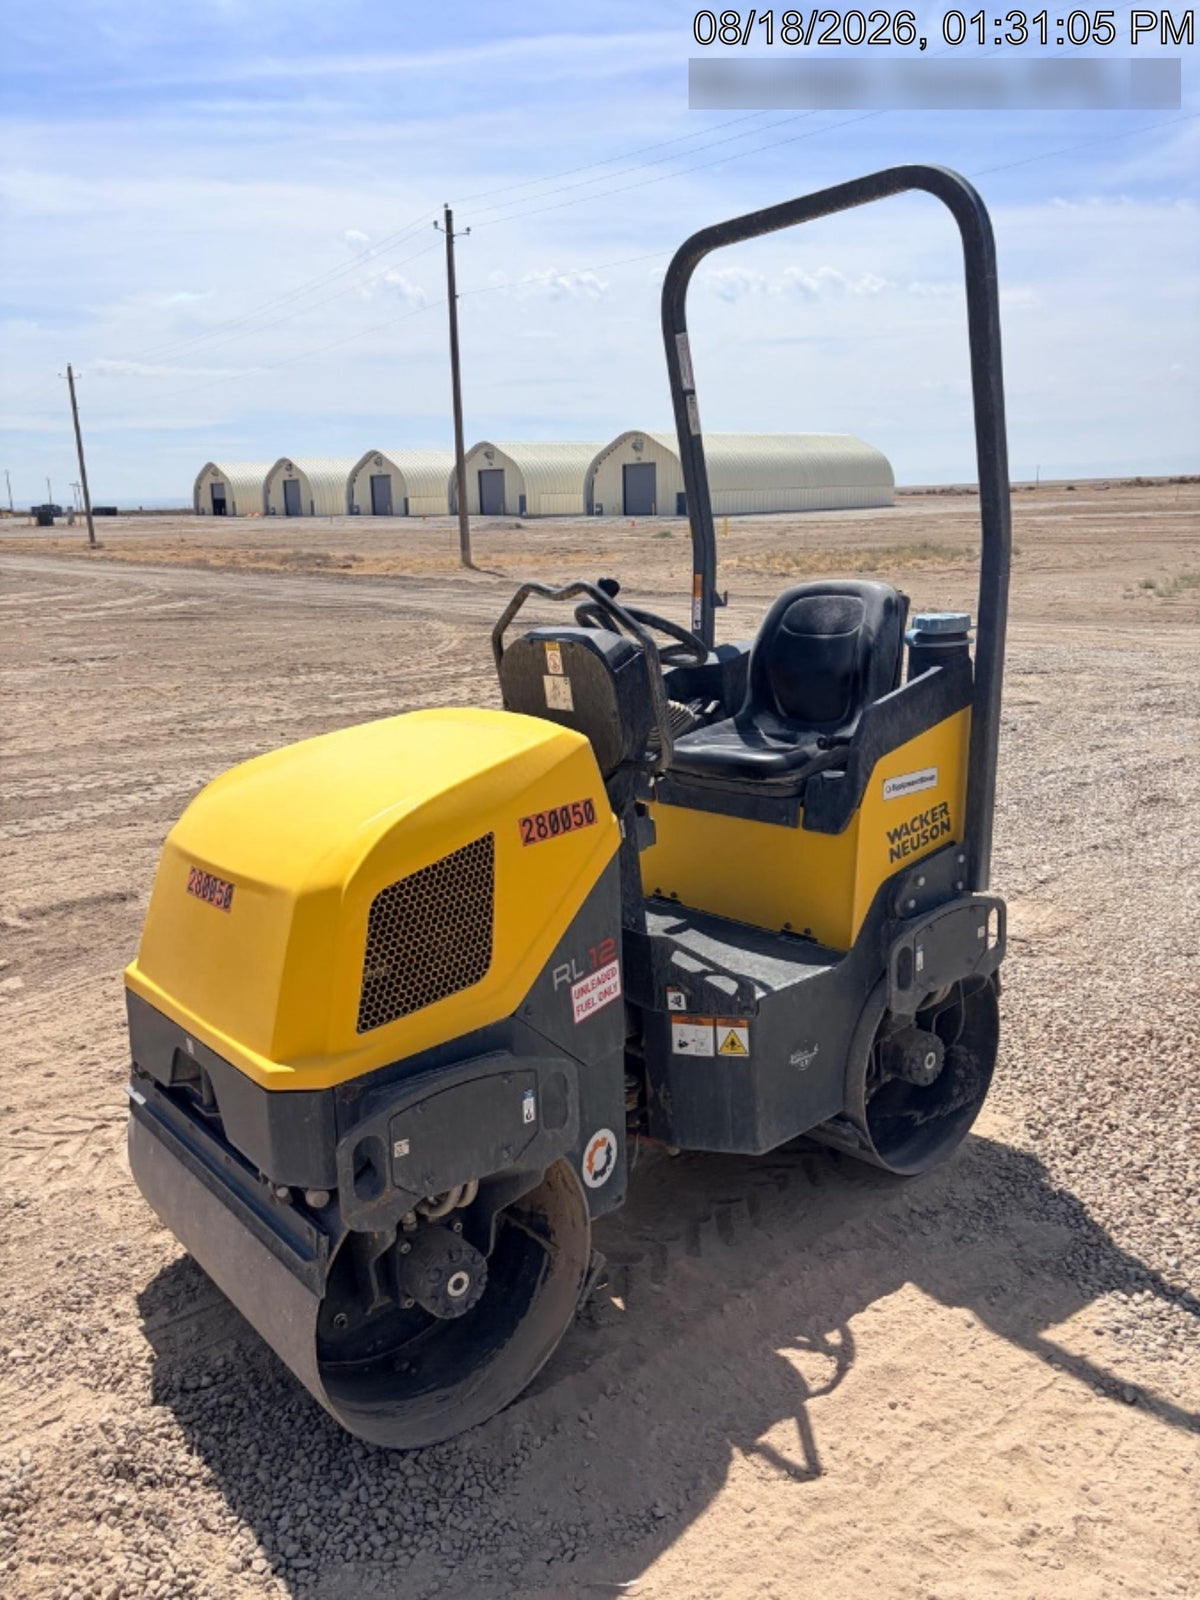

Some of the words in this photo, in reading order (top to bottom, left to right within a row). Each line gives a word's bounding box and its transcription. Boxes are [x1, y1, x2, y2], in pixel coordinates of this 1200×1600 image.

[521, 799, 596, 844] 280050
[886, 801, 951, 845] WACKER
[888, 817, 952, 864] NEUSON
[187, 867, 234, 910] 280050
[573, 966, 618, 1000] UNLEADED
[575, 996, 598, 1017] FUEL
[597, 981, 618, 1002] ONLY
